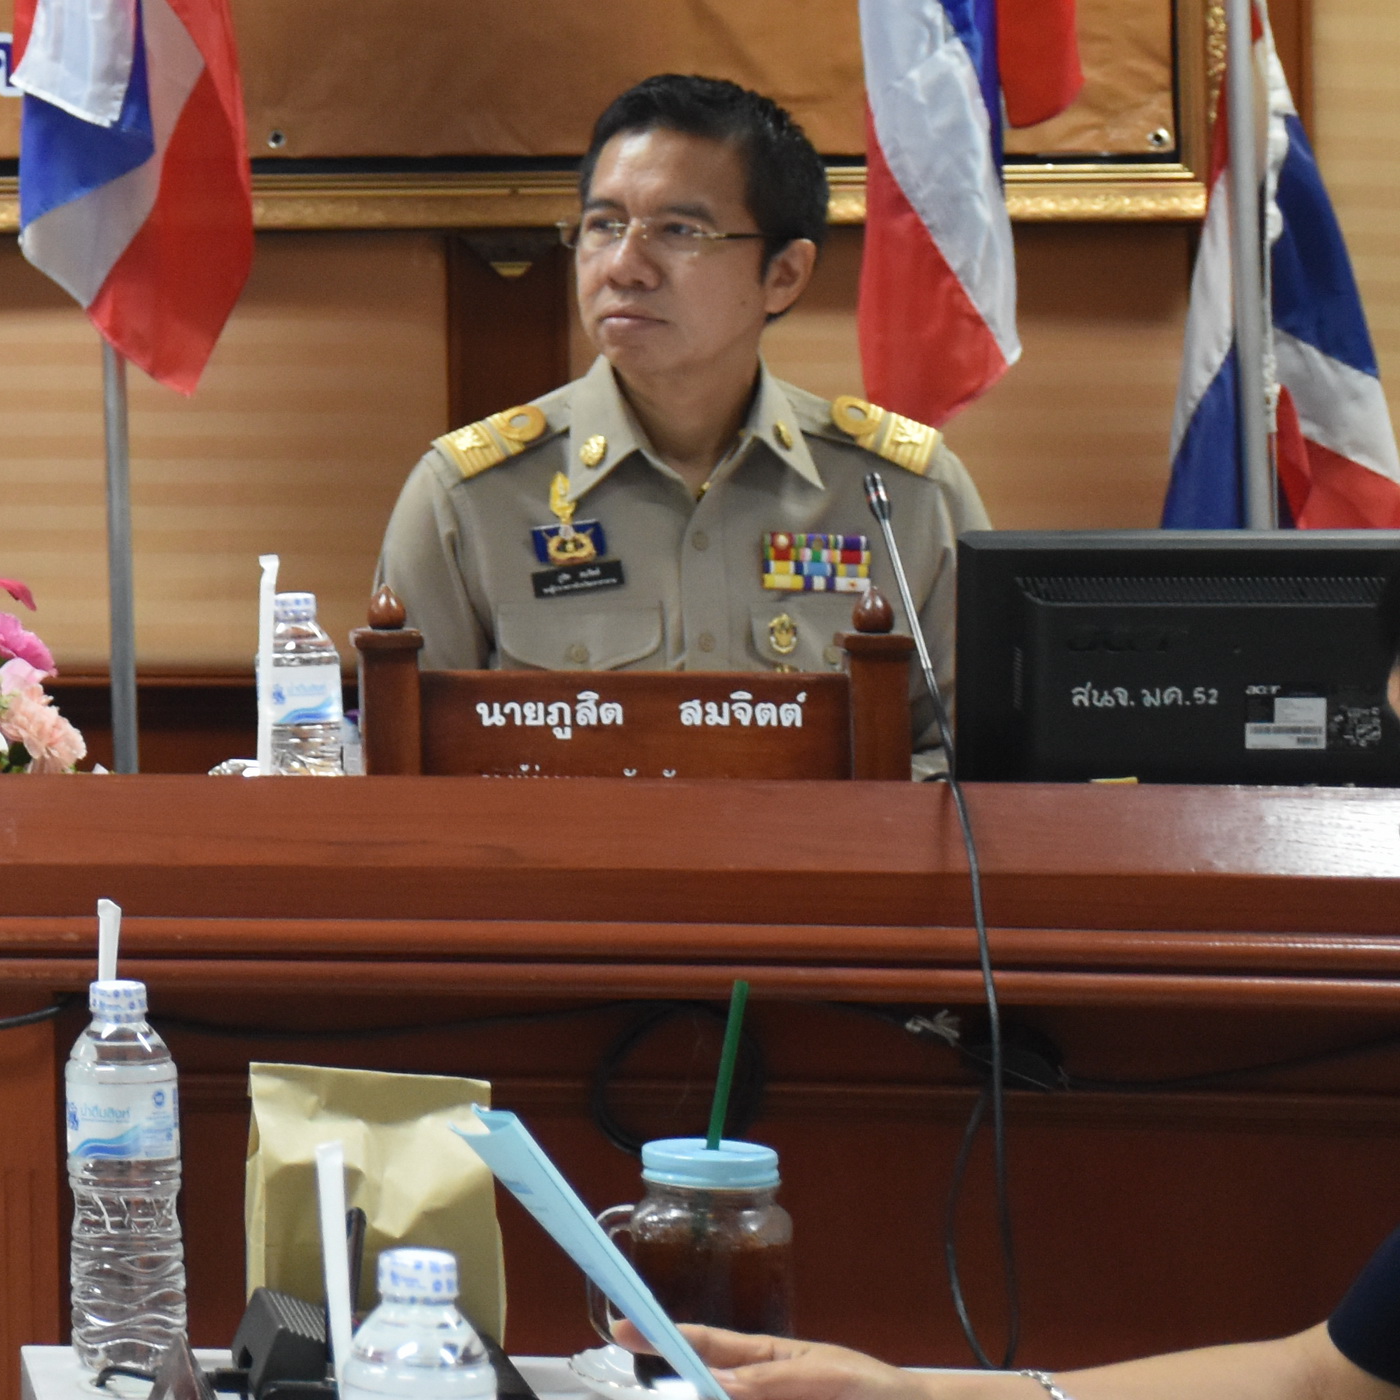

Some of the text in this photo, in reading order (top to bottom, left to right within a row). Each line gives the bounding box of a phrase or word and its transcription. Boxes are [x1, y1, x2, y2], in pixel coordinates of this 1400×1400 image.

[476, 690, 808, 740] นายภูสิต สมจิตต์
